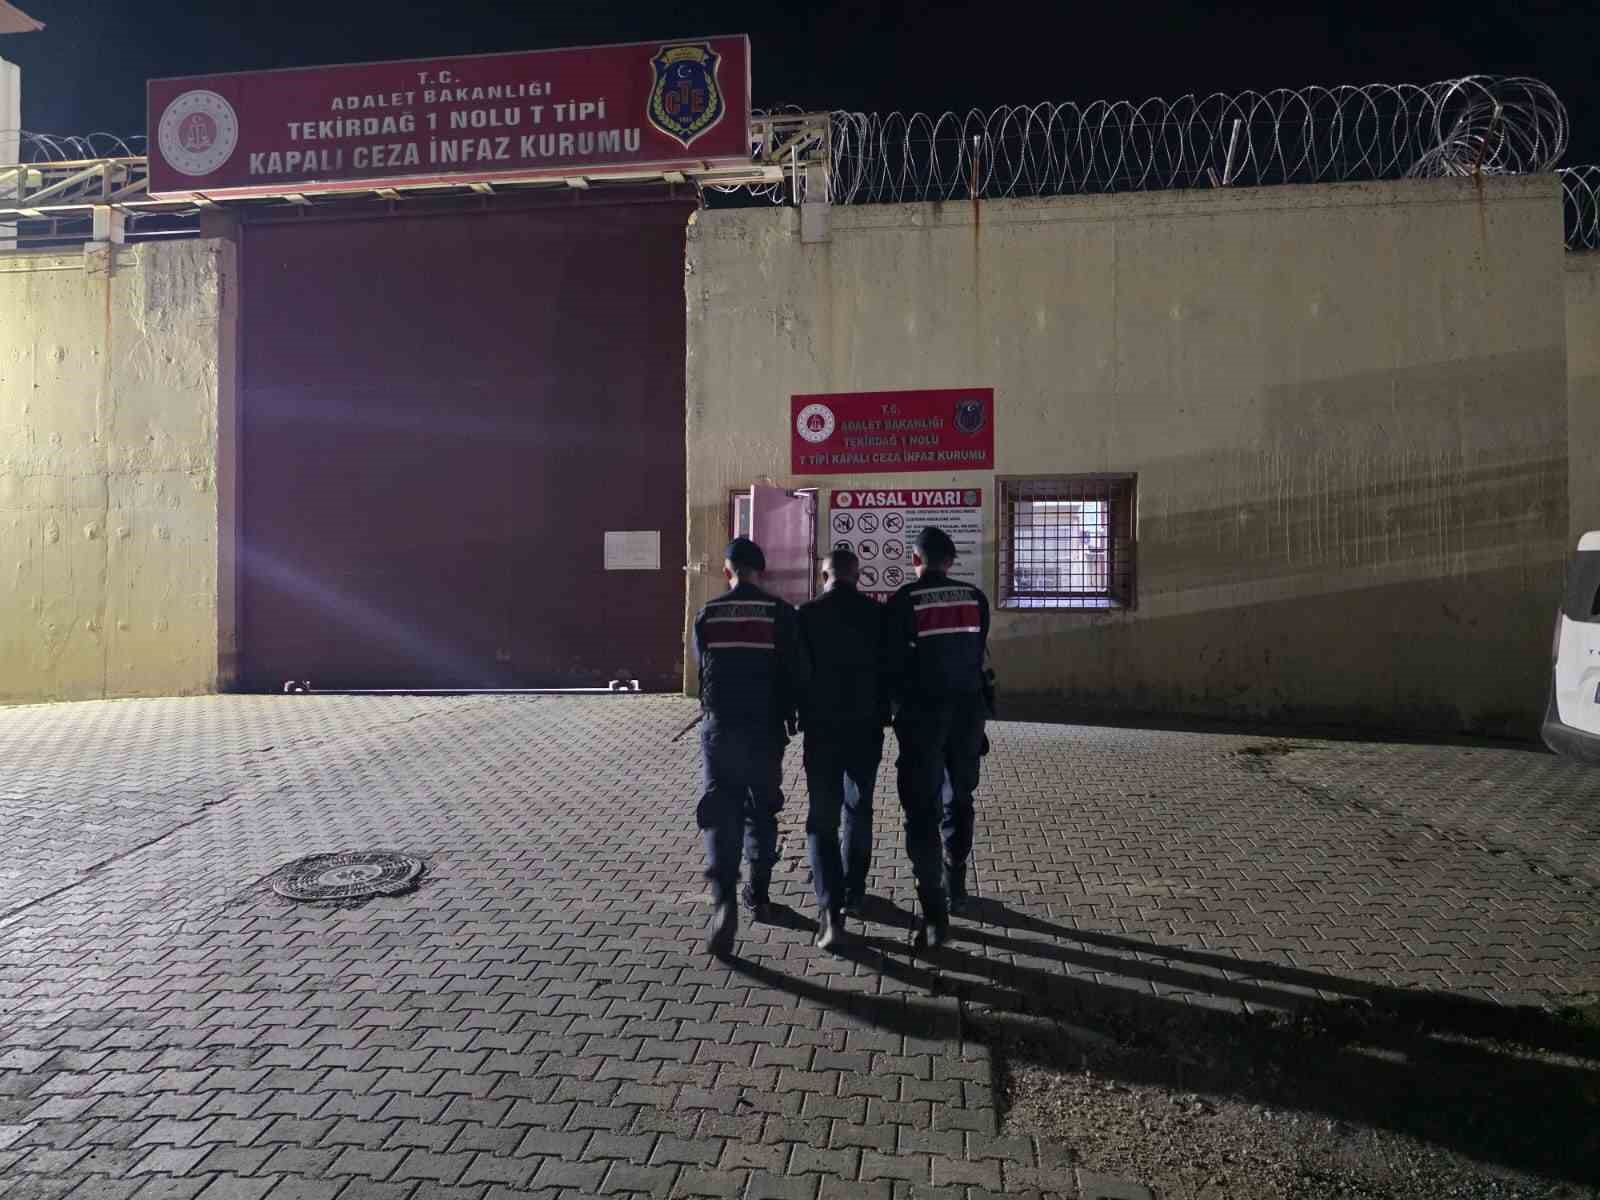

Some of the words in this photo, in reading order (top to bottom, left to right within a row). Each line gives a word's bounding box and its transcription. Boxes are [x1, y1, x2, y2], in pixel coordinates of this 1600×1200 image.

[417, 71, 461, 85] T.C.
[331, 91, 416, 112] ADALET
[423, 80, 552, 104] BAKANLIĞI
[288, 112, 416, 141] TEKİRDAĞ
[426, 112, 440, 131] 1
[449, 107, 522, 129] NOLU
[530, 105, 545, 124] T
[552, 96, 606, 123] TİPİ
[249, 149, 344, 175] KAPALI
[352, 142, 420, 170] CEZA
[429, 135, 511, 164] İNFAZ
[519, 127, 641, 159] KURUMU
[842, 420, 881, 432] ADALET
[910, 434, 939, 446] NOLU
[832, 452, 870, 465] KAPALI
[873, 451, 903, 463] CEZA
[937, 447, 986, 461] KURUMU
[855, 491, 907, 507] YASAL
[911, 490, 961, 506] UYARI
